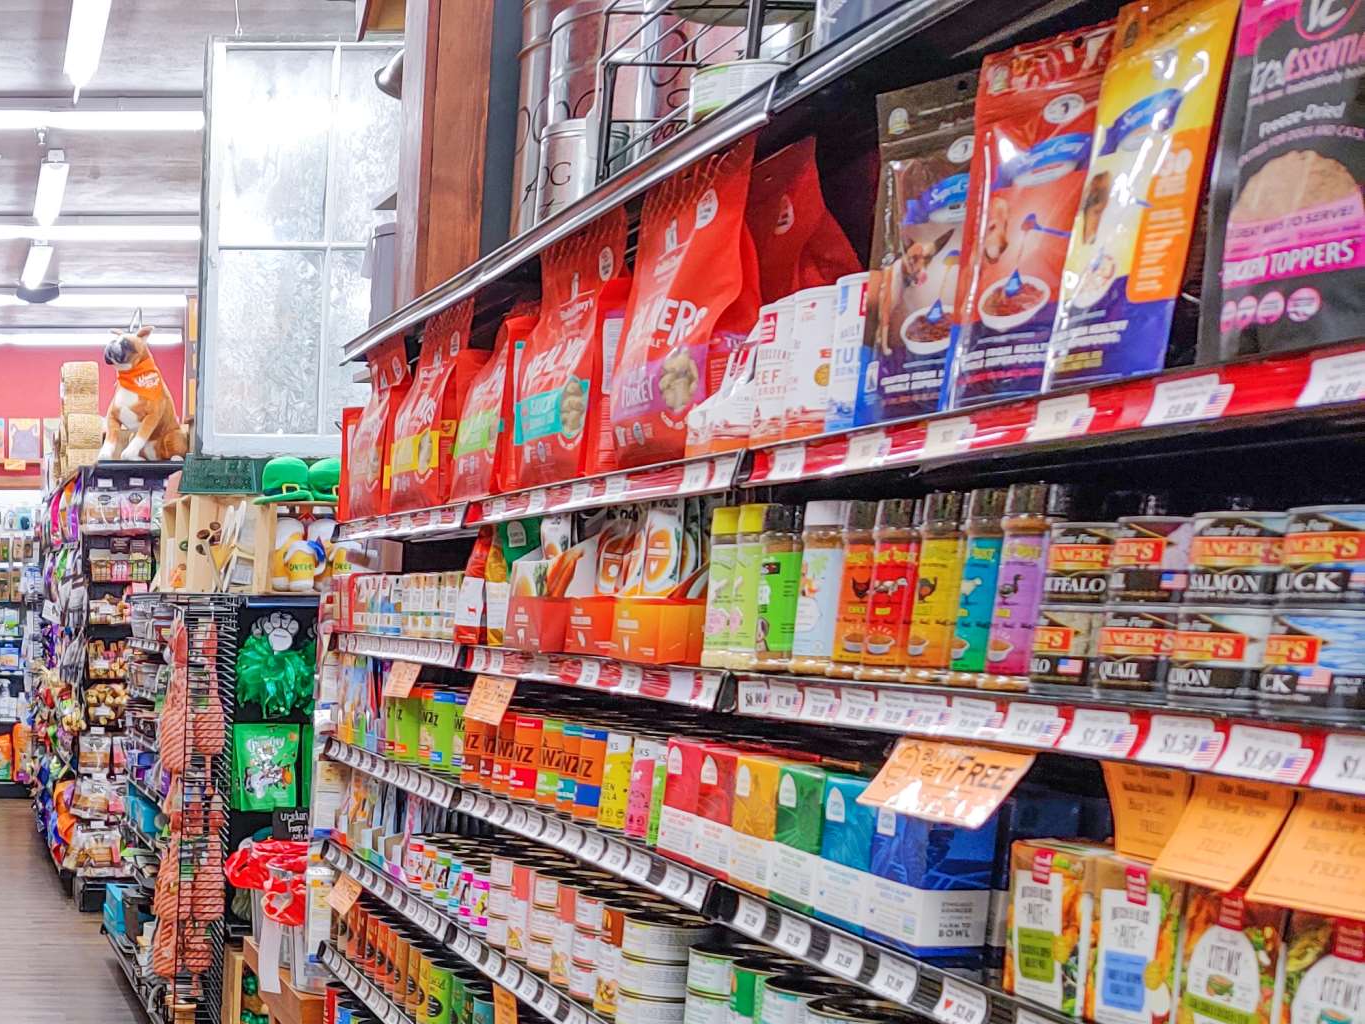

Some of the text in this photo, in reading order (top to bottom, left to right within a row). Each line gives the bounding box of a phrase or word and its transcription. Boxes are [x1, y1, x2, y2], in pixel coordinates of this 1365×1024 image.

[1269, 239, 1355, 278] TOPPERS
[1097, 661, 1142, 681] QUAIL
[952, 754, 1018, 789] FREE
[938, 928, 972, 939] BOWL
